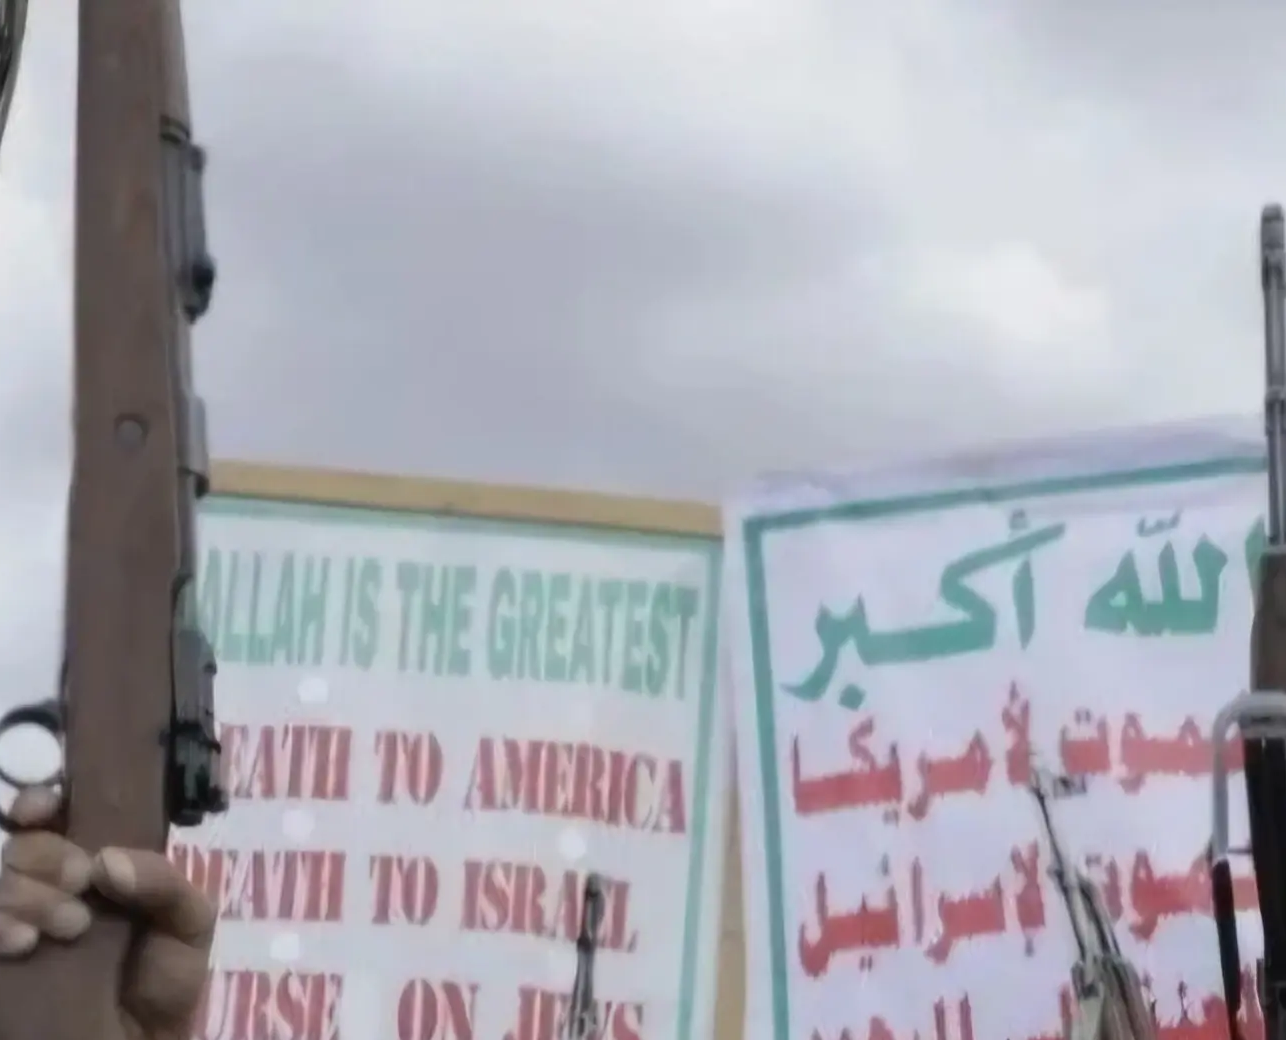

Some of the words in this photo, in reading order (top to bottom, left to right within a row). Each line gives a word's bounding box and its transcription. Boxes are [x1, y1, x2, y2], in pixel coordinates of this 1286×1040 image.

[200, 549, 332, 667] ALLAH
[338, 557, 383, 670] IS
[395, 562, 479, 677] THE
[487, 568, 702, 701] GREATEST
[782, 507, 1066, 710] أكبر
[219, 722, 353, 801] EATH
[374, 730, 444, 806] TO
[465, 735, 688, 835] AMERICA
[369, 853, 440, 926] TO
